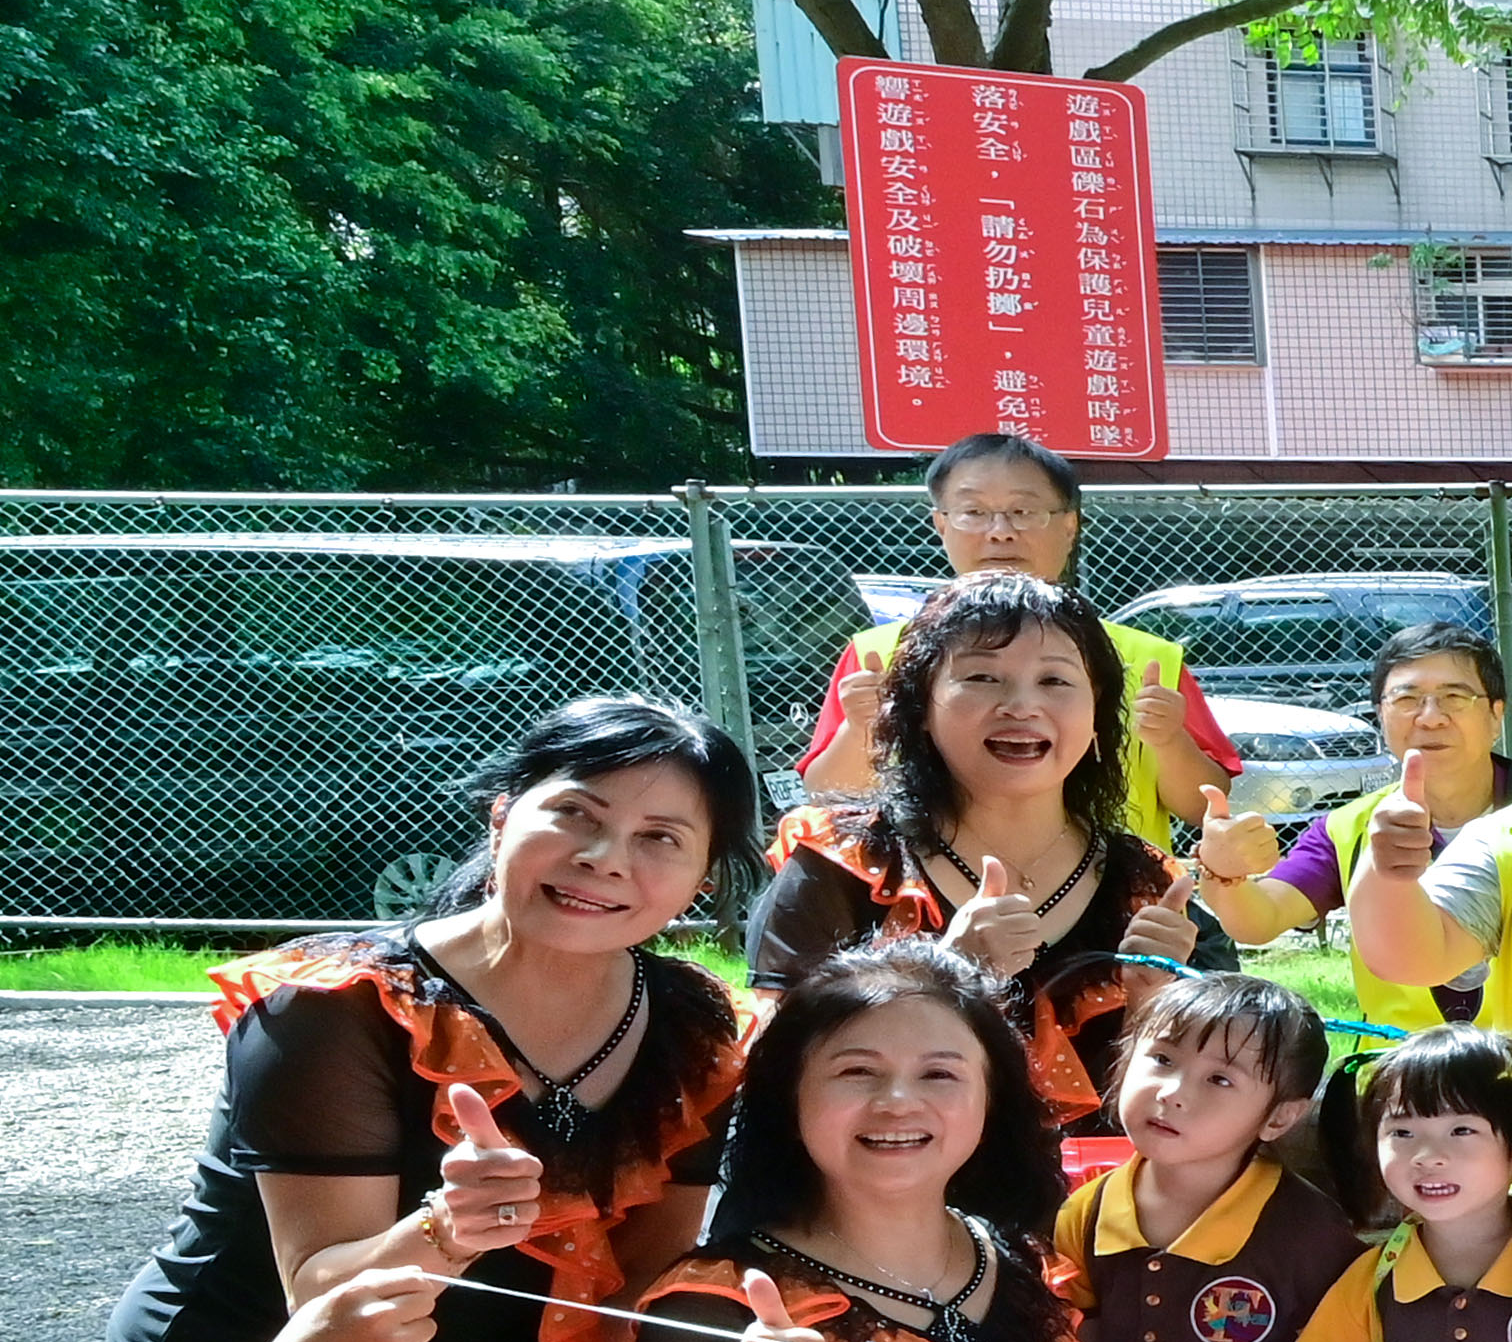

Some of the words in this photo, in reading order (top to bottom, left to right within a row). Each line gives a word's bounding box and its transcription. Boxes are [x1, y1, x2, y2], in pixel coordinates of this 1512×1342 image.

[1066, 94, 1123, 447] 遊戲區礫石為保護兒童遊戲時墜
